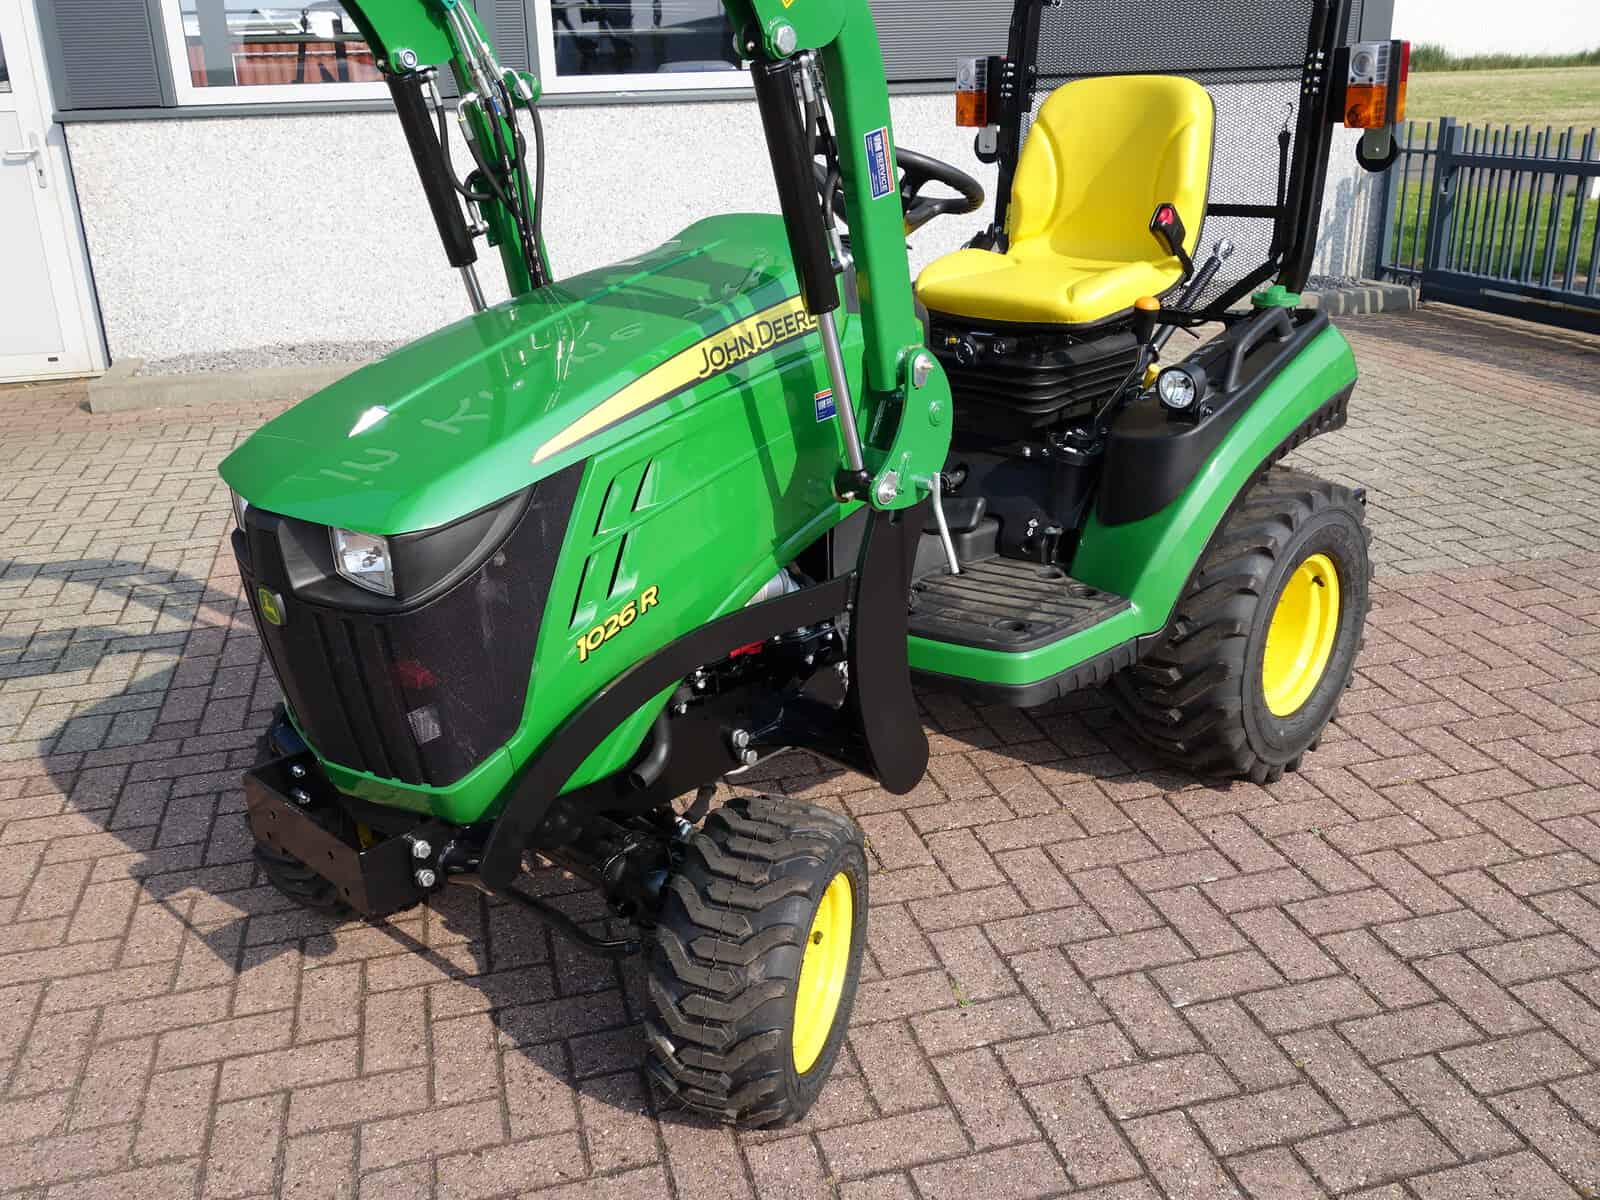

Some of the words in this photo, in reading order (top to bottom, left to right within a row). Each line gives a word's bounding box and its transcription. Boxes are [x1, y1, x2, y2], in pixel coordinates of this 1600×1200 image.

[699, 331, 755, 375] JOHN
[576, 599, 638, 663] 1026
[640, 585, 659, 615] R
